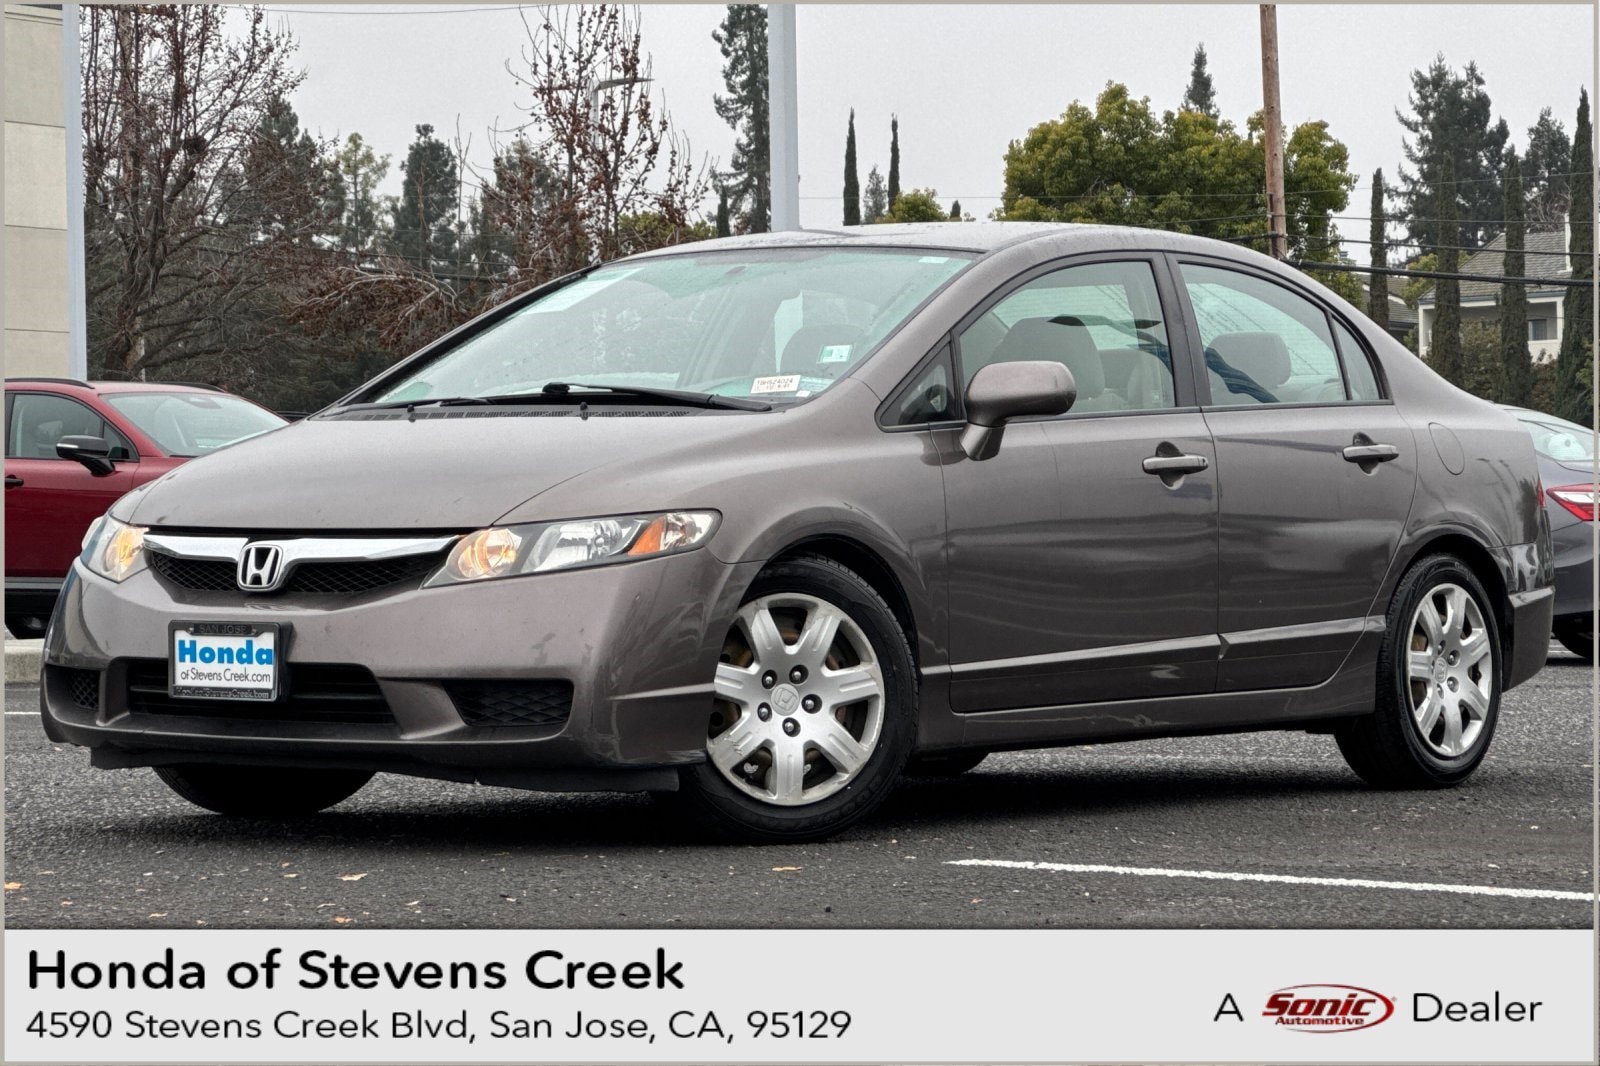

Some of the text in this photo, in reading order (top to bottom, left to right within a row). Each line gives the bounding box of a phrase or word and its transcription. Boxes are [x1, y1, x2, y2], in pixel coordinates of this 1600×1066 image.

[199, 624, 247, 635] SAN JOSE
[178, 639, 273, 665] Honda
[180, 667, 271, 683] of Stevens Creek.com
